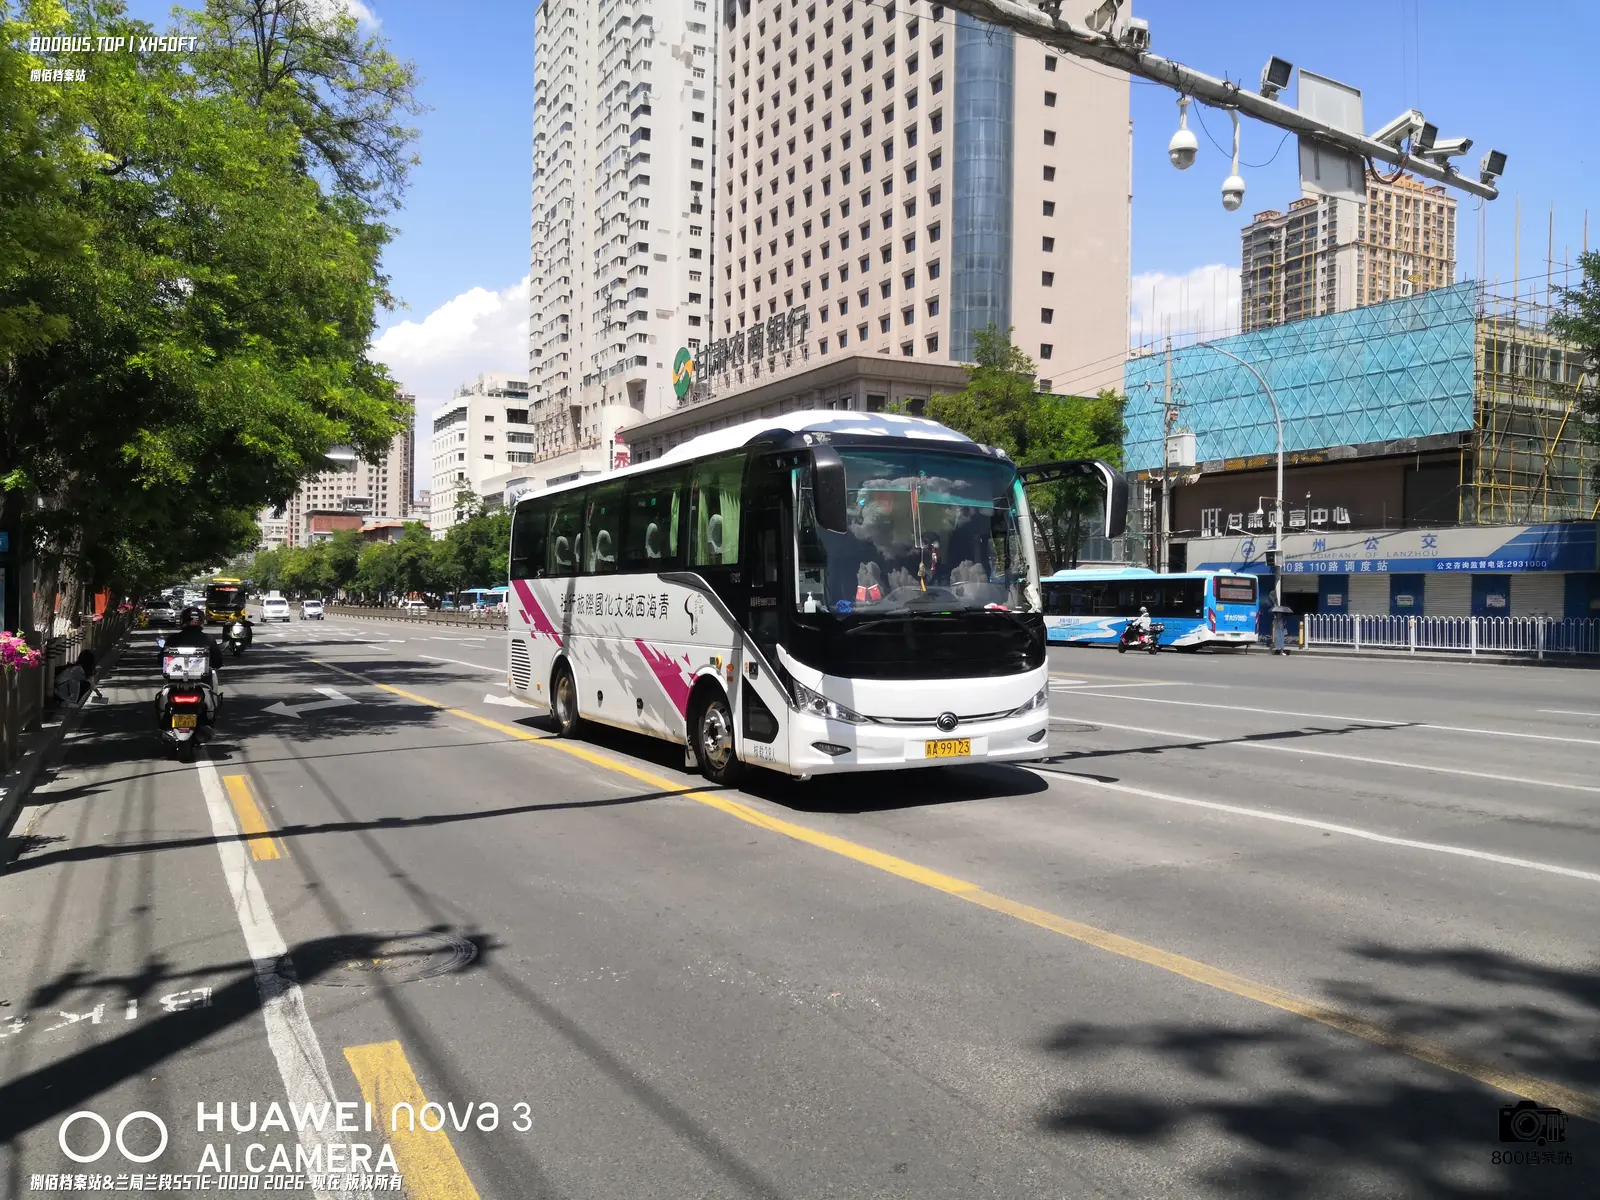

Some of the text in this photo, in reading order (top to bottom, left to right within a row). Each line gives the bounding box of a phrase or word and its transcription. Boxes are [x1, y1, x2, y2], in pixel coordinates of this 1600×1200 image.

[695, 304, 809, 383] 甘肃农商银行
[1386, 550, 1439, 558] LANZHOU
[1309, 561, 1339, 572] 110路
[1344, 560, 1389, 572] 调度站
